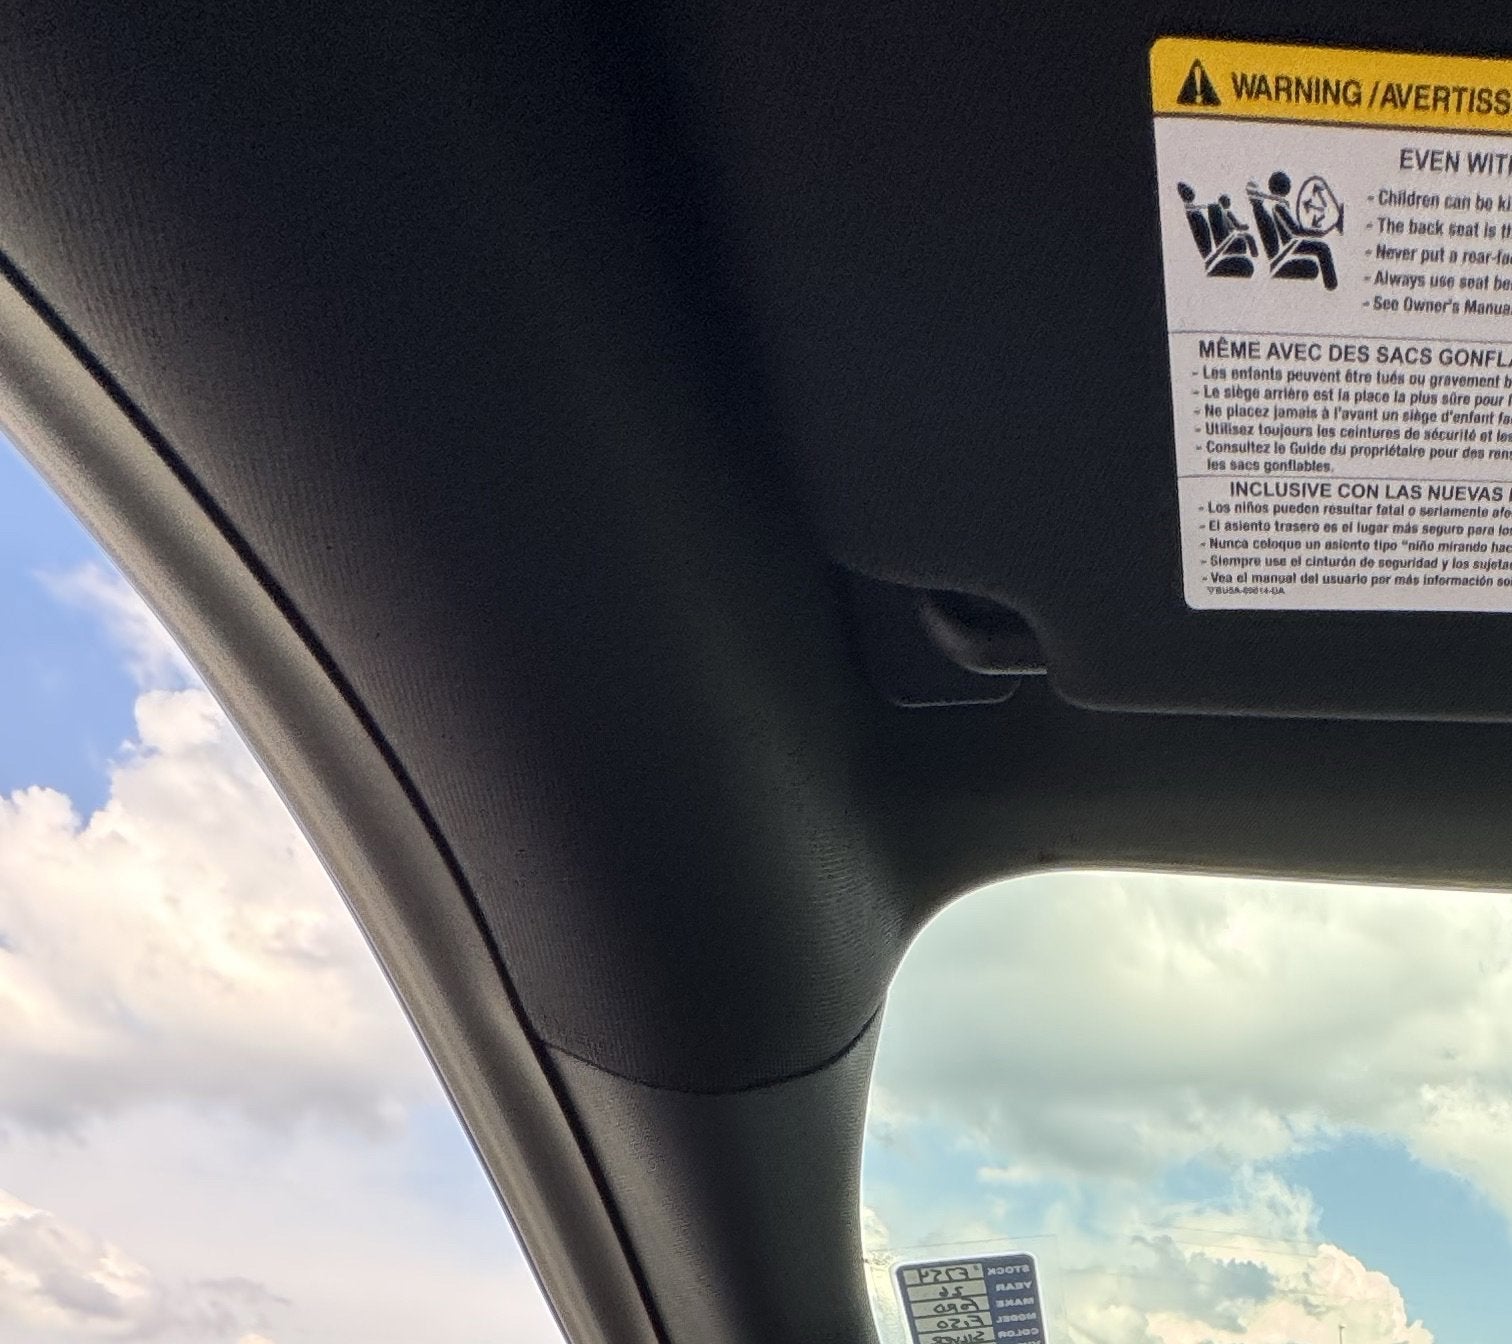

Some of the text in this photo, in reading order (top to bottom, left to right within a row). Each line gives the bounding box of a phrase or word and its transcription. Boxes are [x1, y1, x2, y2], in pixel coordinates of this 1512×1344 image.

[1231, 71, 1362, 108] WARNING
[1399, 147, 1460, 173] EVEN
[1378, 188, 1440, 209] Children
[1444, 195, 1471, 210] can
[1474, 193, 1493, 211] be
[1376, 216, 1404, 234] The
[1408, 218, 1444, 236] back
[1448, 221, 1479, 238] seat
[1483, 222, 1497, 238] is
[1374, 270, 1425, 290] Always
[1429, 275, 1454, 288] use
[1459, 274, 1489, 290] seat
[1198, 336, 1260, 360] MÊME
[1266, 341, 1321, 361] AVEC
[1329, 344, 1369, 363] DES
[1376, 345, 1432, 365] SACS
[1230, 481, 1331, 499] INCLUSIVE
[1337, 483, 1378, 499] CON
[1385, 484, 1422, 499] LAS
[1427, 485, 1504, 502] NUEVAS
